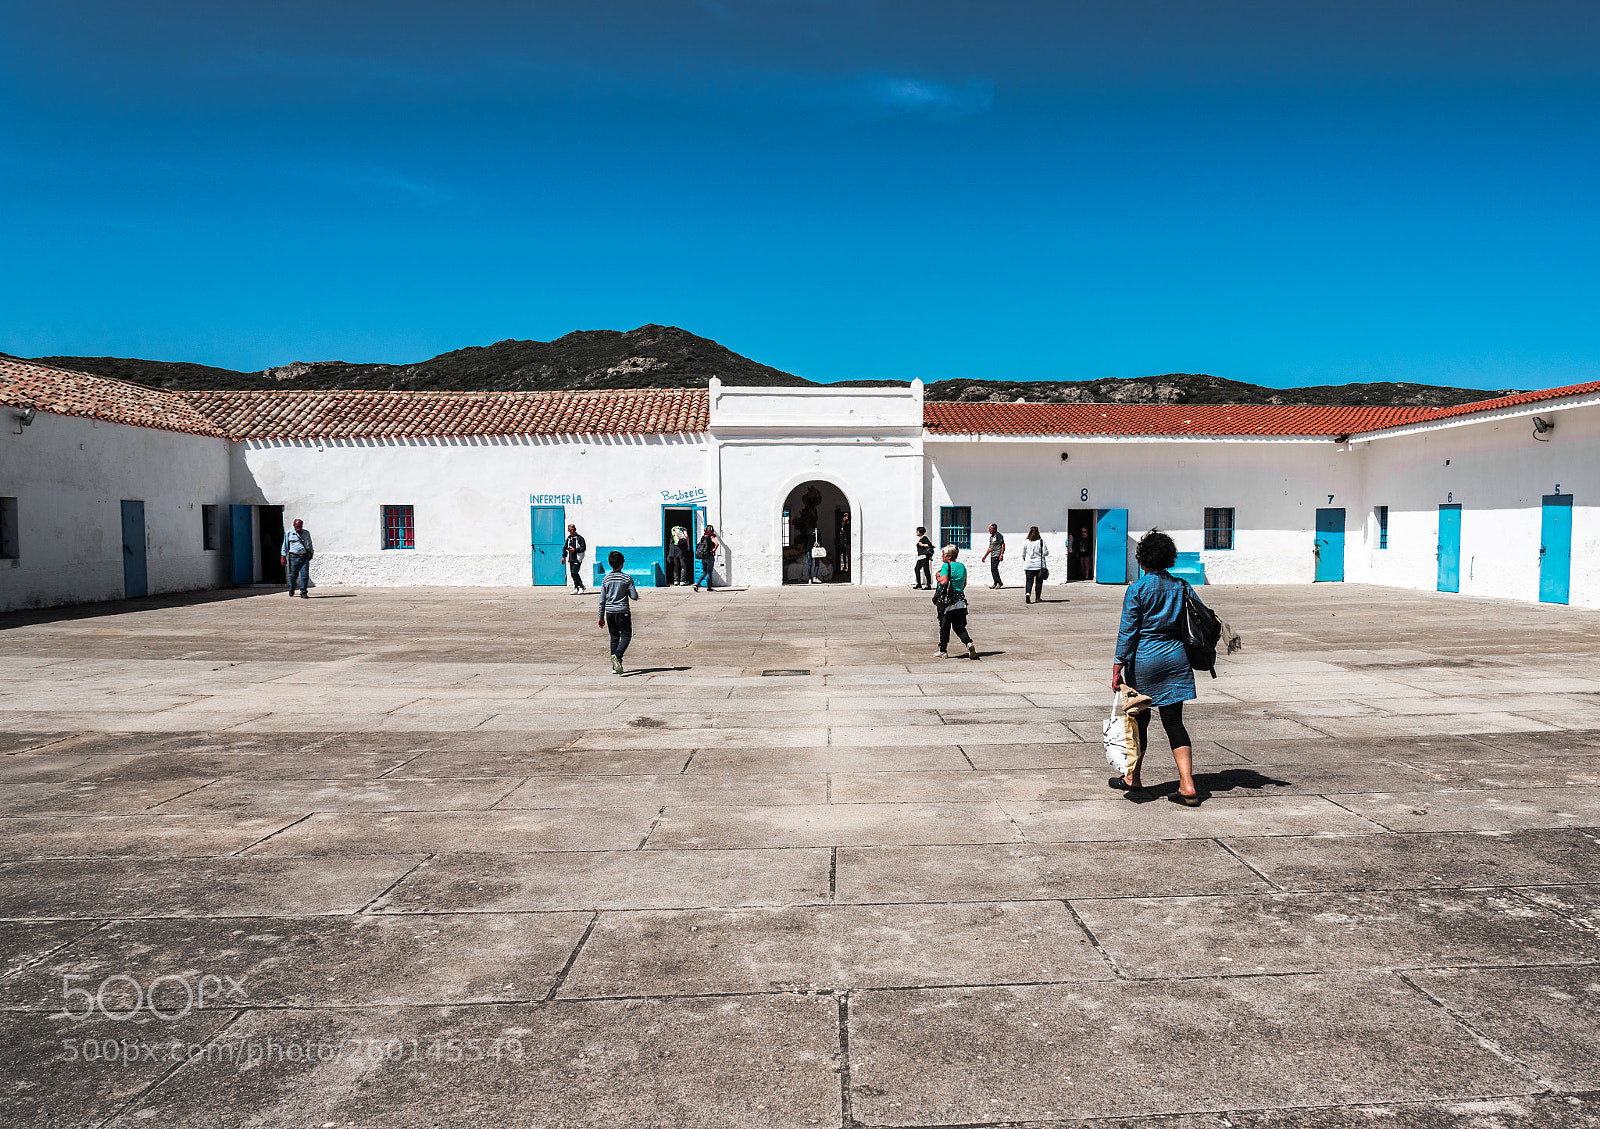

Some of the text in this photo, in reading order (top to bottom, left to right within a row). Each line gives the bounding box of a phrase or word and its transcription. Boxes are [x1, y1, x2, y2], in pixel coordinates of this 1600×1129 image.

[1080, 487, 1089, 502] 8
[1554, 483, 1561, 495] 5
[1327, 494, 1335, 505] 7
[1447, 491, 1453, 503] 6
